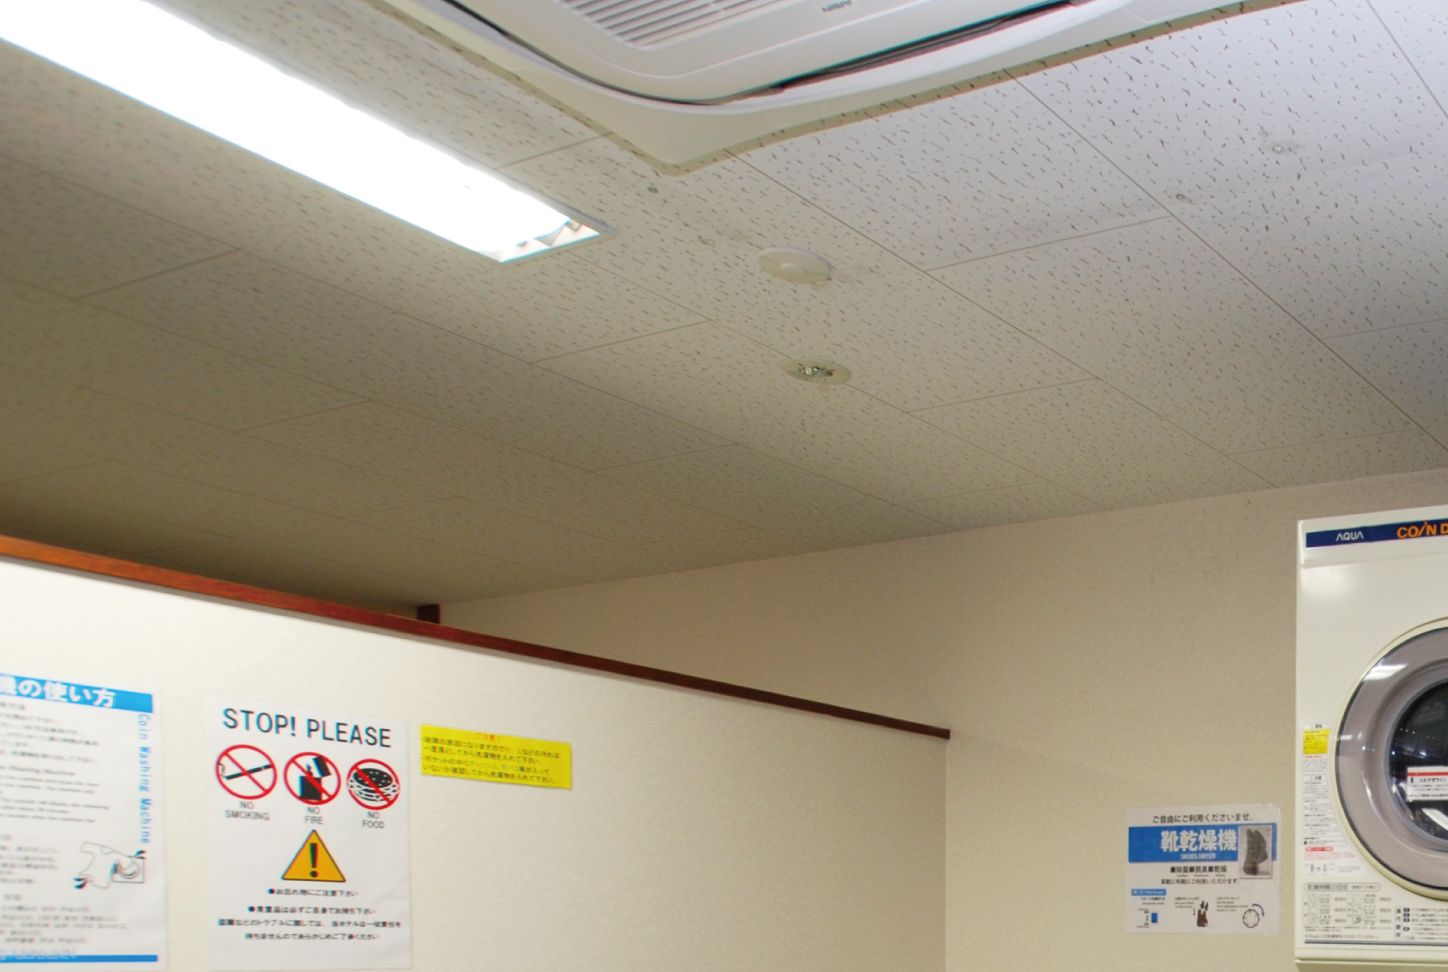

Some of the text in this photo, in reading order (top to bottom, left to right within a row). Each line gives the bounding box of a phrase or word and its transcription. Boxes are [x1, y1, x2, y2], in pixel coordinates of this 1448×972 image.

[1336, 531, 1364, 542] AQUA
[223, 707, 391, 748] STOP! PLEASE
[138, 747, 151, 791] Washing
[239, 801, 254, 810] NO
[306, 806, 321, 815] NO
[225, 809, 270, 821] SMOKING
[304, 815, 324, 825] FIRE
[366, 811, 380, 820] NO
[139, 799, 152, 843] Machine
[361, 819, 385, 829] FOOD
[1160, 829, 1238, 853] 靴乾燥機
